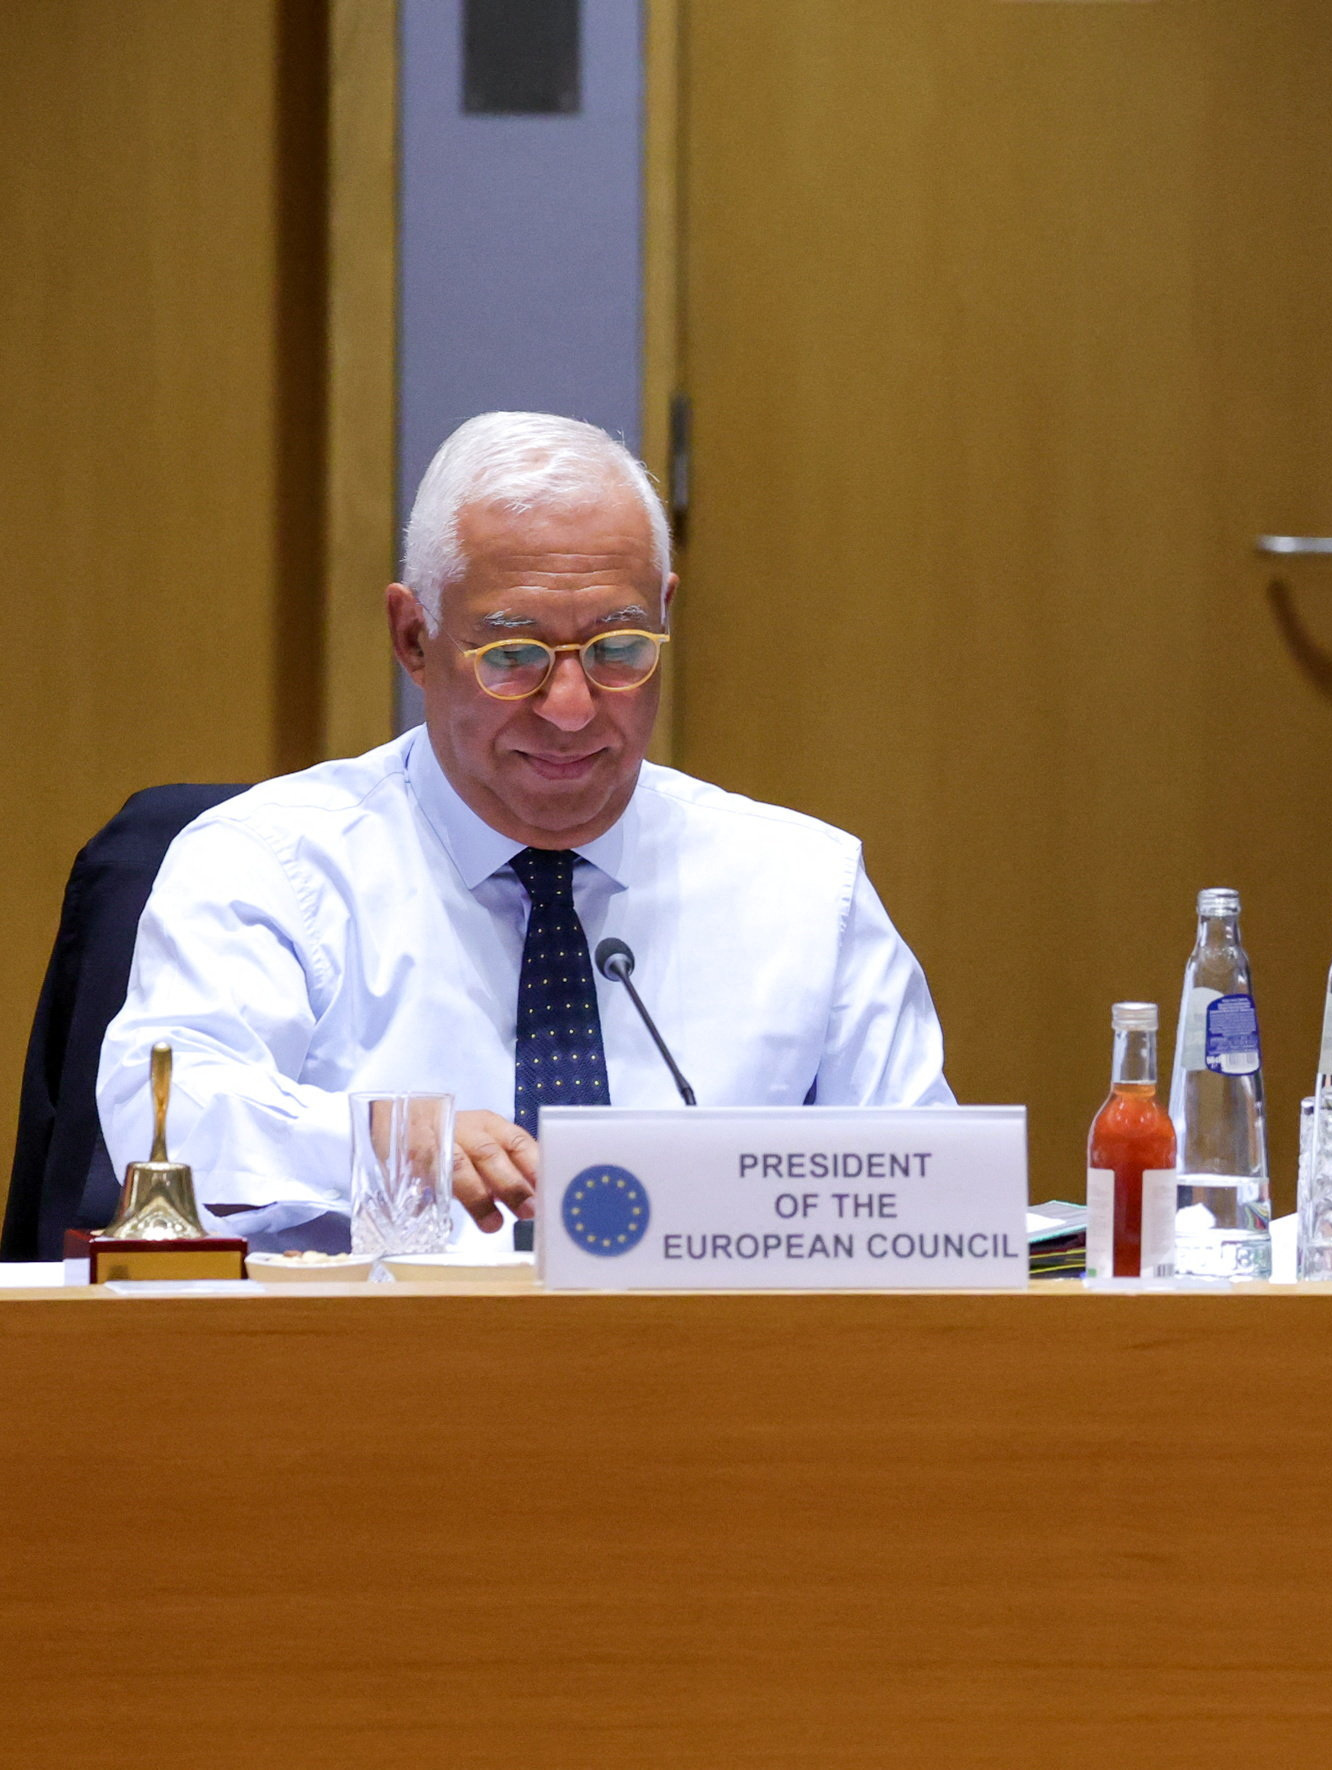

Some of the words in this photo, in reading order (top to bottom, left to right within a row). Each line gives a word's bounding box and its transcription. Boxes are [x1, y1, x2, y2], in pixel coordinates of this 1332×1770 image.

[739, 1152, 932, 1179] PRESIDENT
[774, 1193, 819, 1220] OF
[831, 1193, 898, 1219] THE
[663, 1233, 854, 1260] EUROPEAN
[866, 1232, 1019, 1259] COUNCIL
